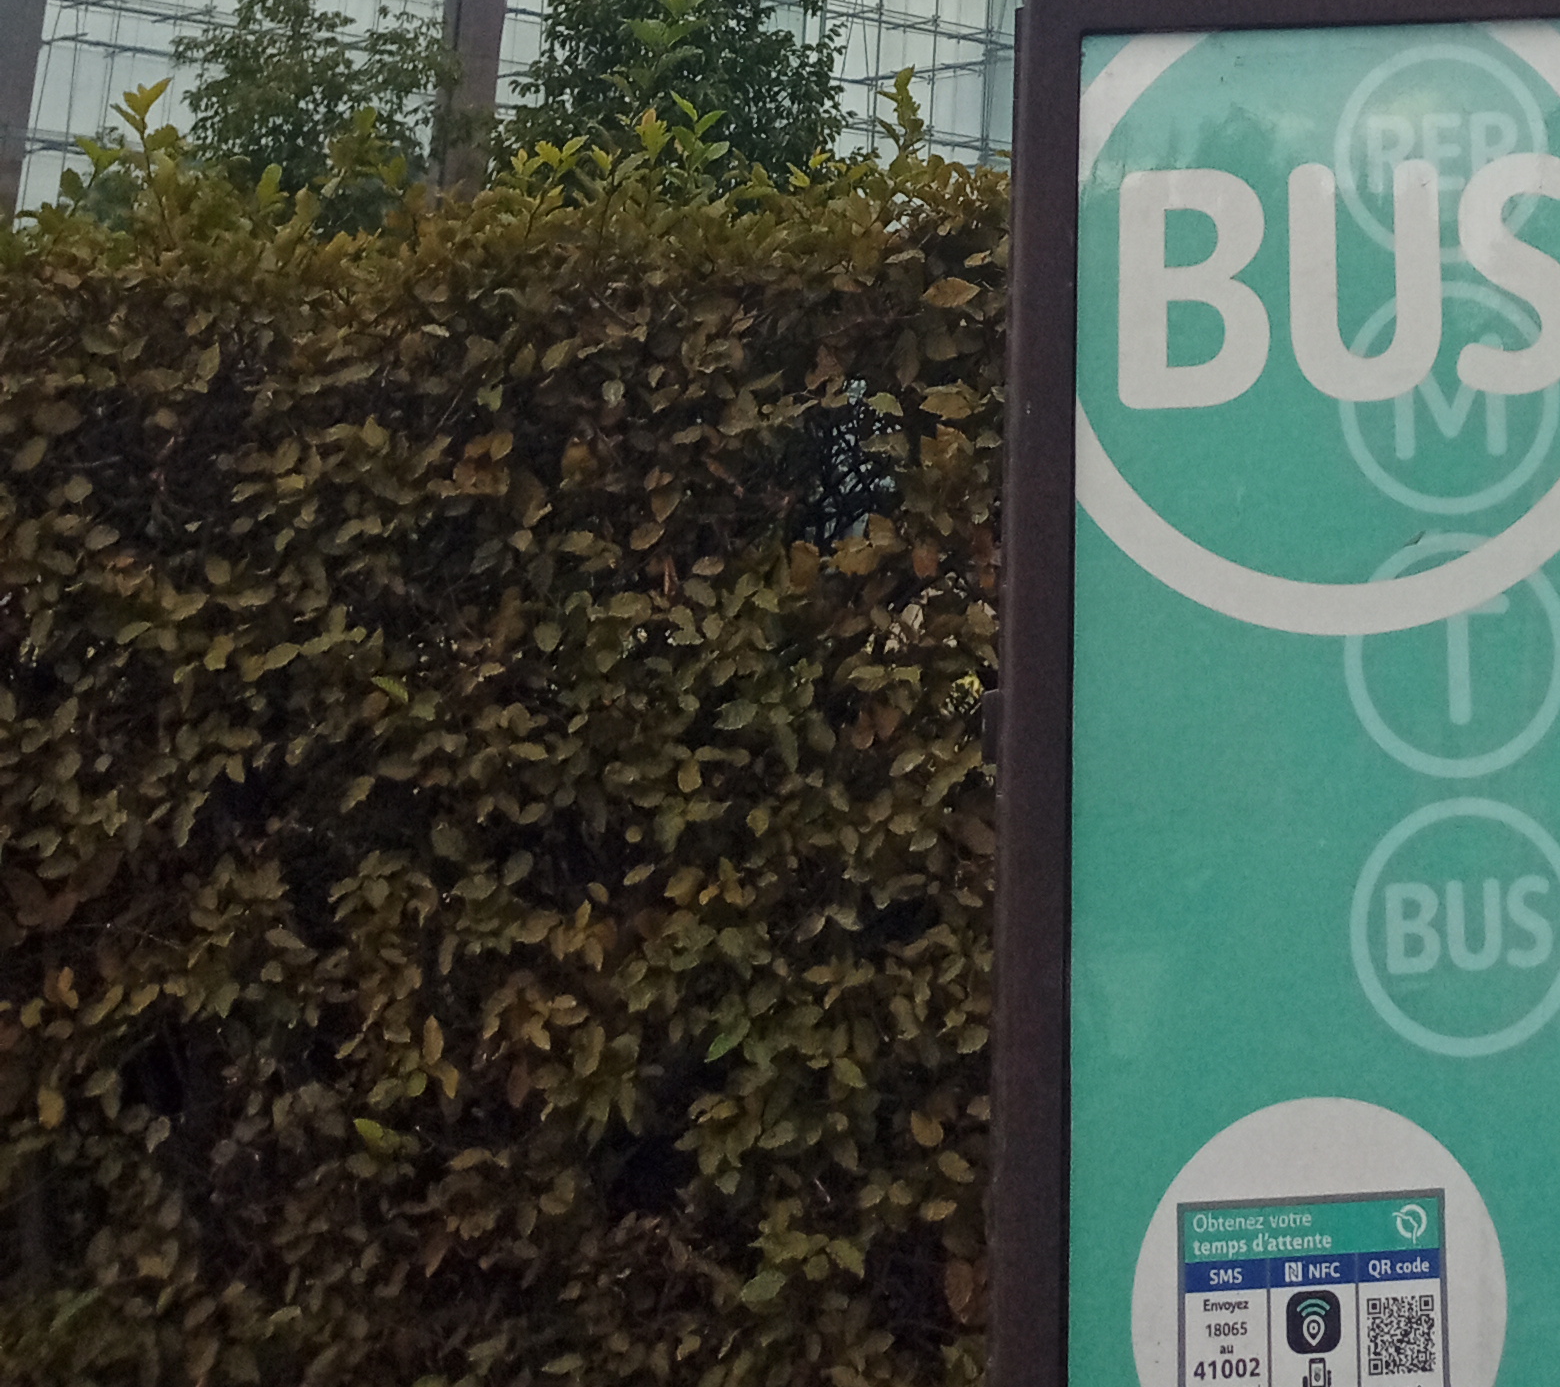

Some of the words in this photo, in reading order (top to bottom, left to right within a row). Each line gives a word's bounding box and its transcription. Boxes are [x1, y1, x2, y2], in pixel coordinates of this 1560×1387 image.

[1385, 875, 1554, 975] BUS
[1192, 1213, 1264, 1234] Obtenez
[1269, 1211, 1312, 1228] votre
[1193, 1237, 1247, 1256] temps
[1308, 1262, 1341, 1278] NFC
[1368, 1259, 1391, 1277] QR
[1395, 1256, 1430, 1274] code
[1209, 1268, 1243, 1285] SMS
[1203, 1298, 1249, 1313] Envoyez
[1205, 1322, 1248, 1337] 18065
[1219, 1344, 1234, 1355] au
[1193, 1357, 1261, 1380] 41002
